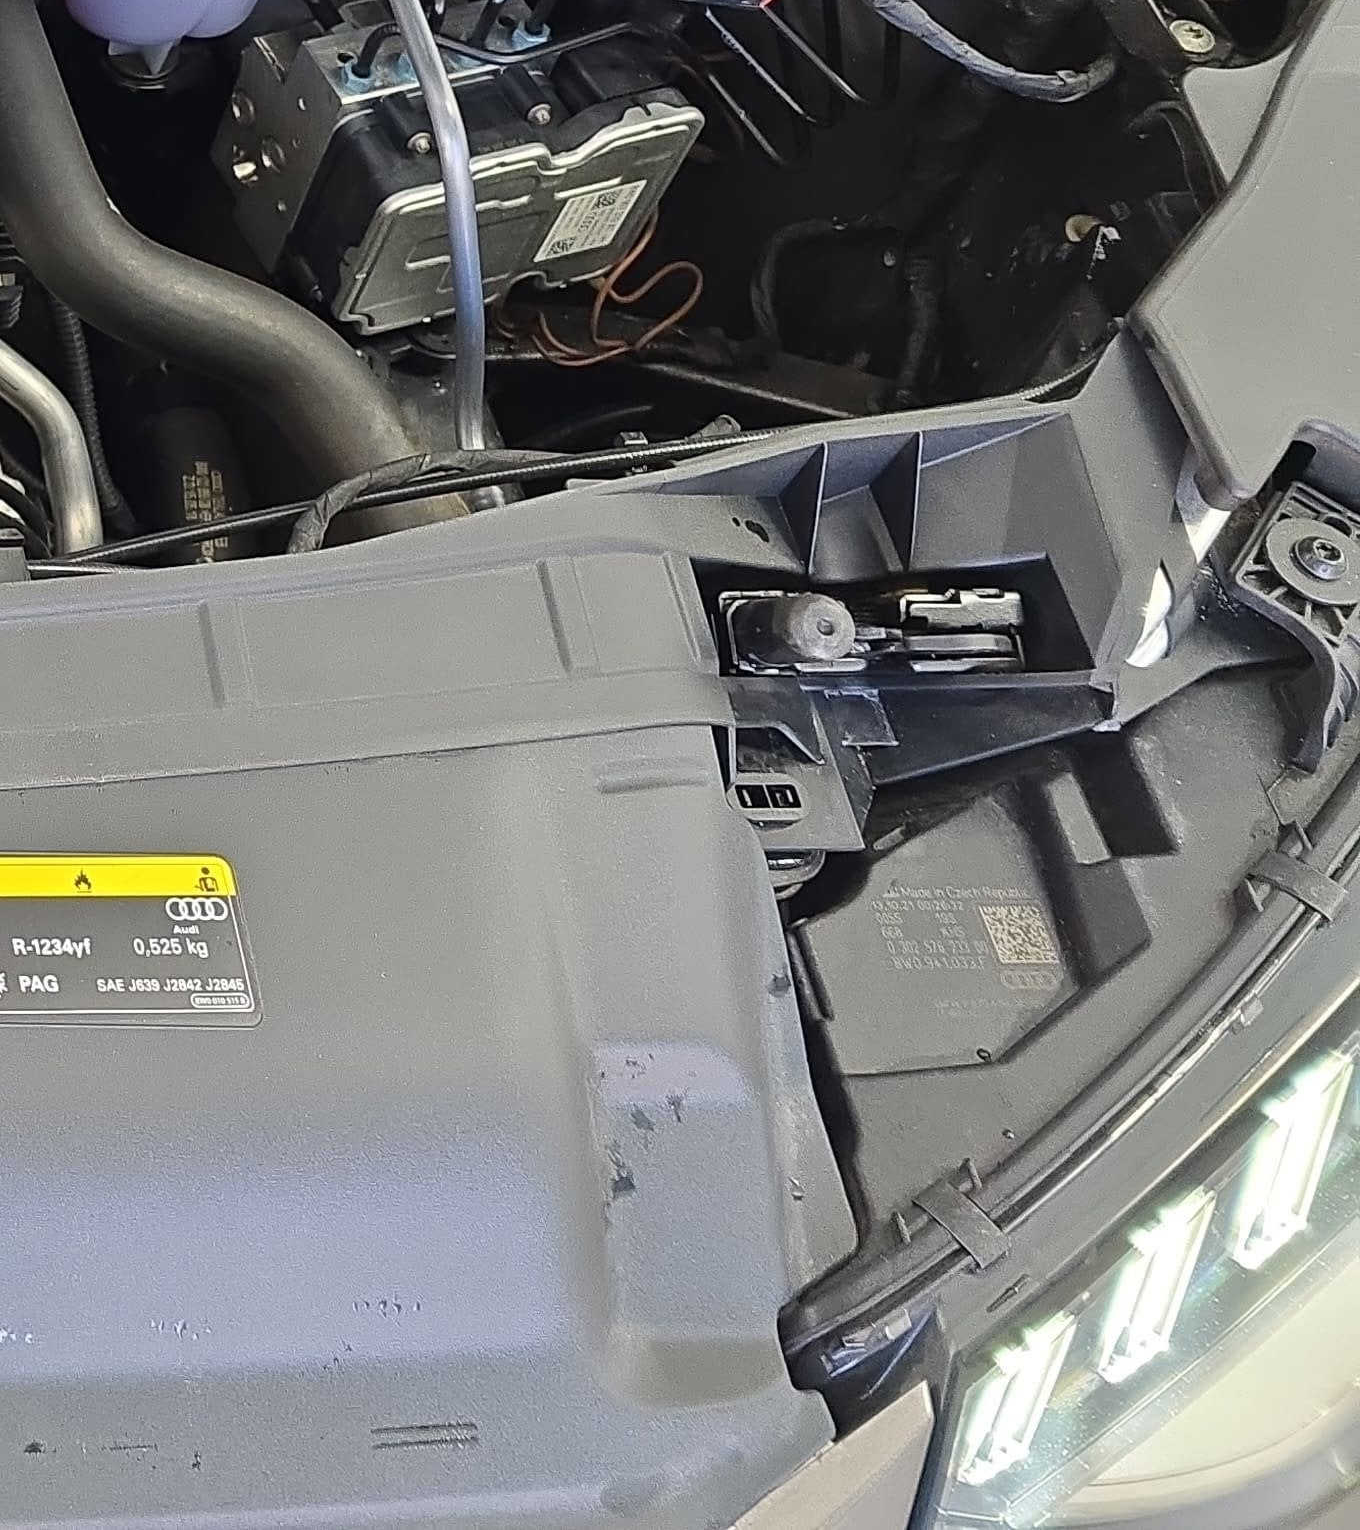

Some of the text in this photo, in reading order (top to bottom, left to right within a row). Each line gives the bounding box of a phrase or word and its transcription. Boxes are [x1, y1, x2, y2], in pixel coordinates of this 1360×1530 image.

[173, 925, 200, 935] Audi
[11, 937, 209, 959] R-1234yf 0,525 kg
[18, 975, 245, 993] PAG SAE J639 J2842 J2845
